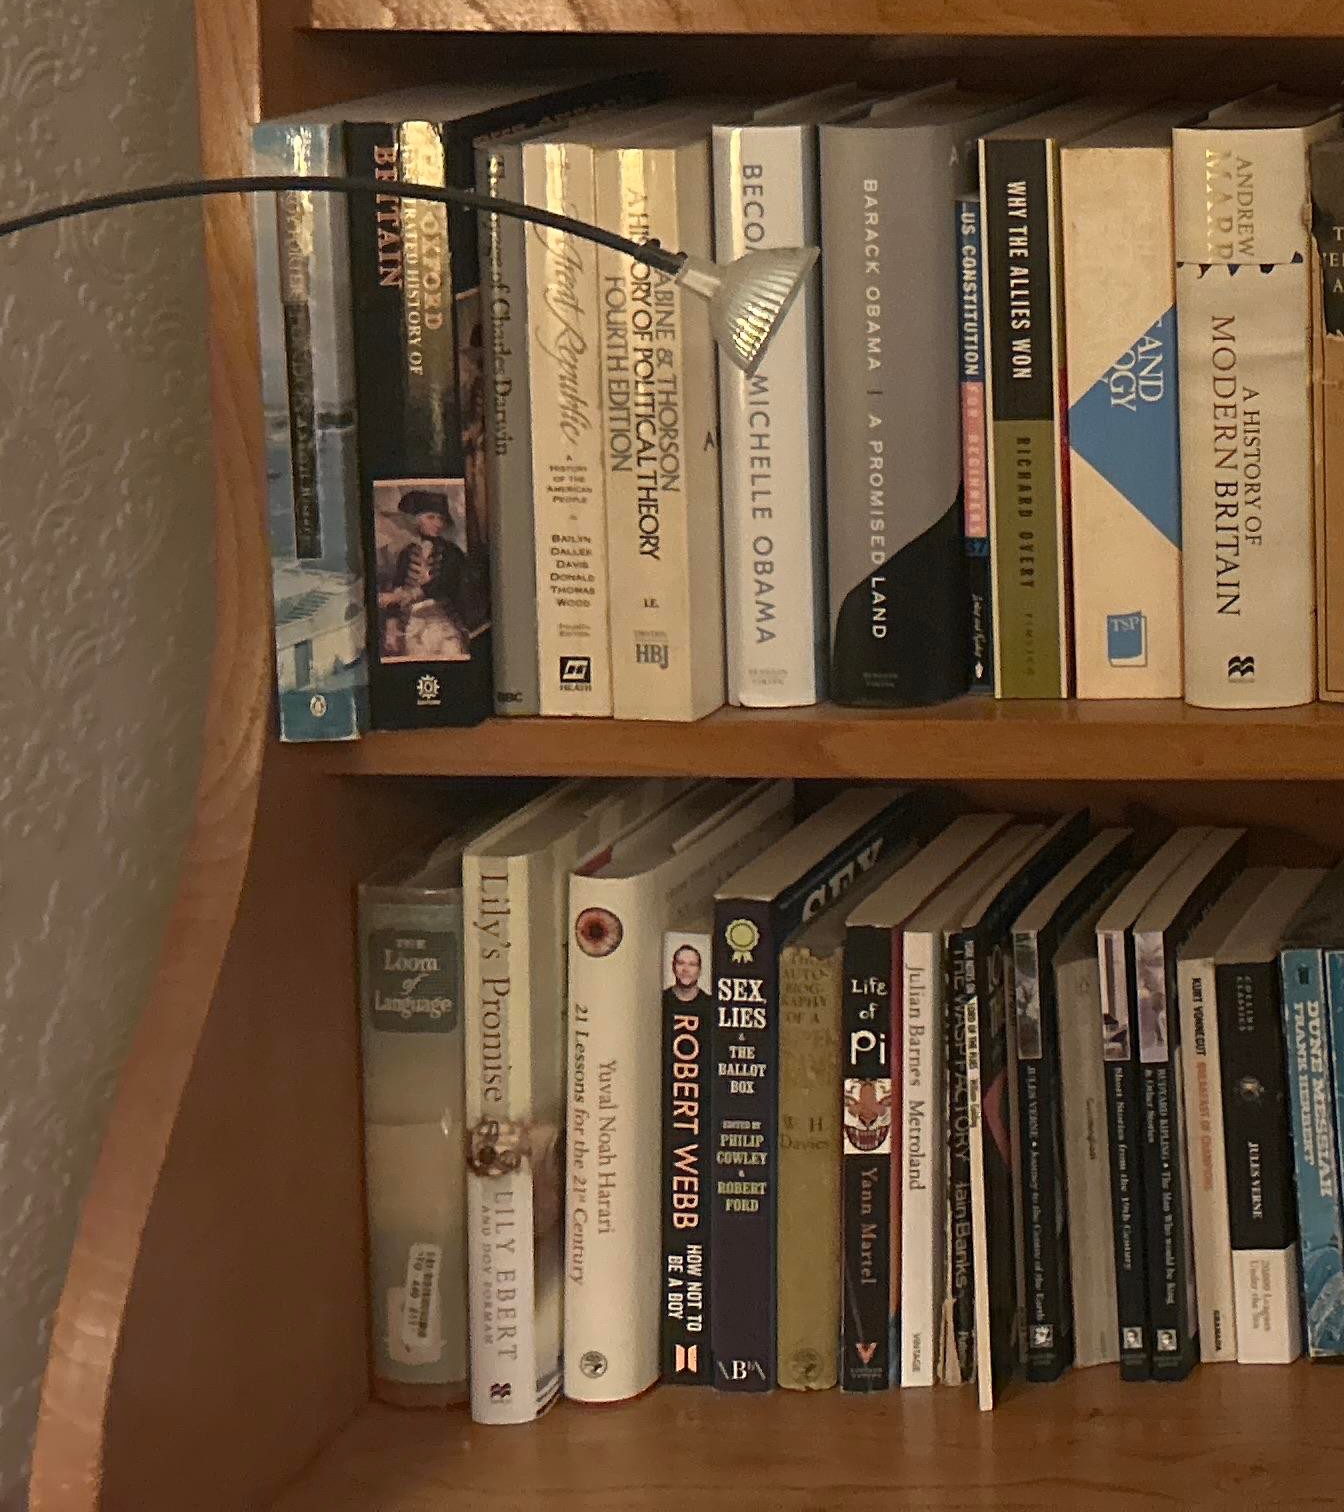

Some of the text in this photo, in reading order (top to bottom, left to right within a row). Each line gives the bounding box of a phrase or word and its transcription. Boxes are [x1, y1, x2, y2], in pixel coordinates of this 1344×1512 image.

[745, 376, 776, 645] MICHELLE OBAMA
[1211, 316, 1240, 616] MODERN BRITAIN
[482, 976, 513, 1103] Promise
[718, 1007, 765, 1029] LIES
[851, 978, 887, 996] Life
[852, 1032, 885, 1065] Pi
[671, 1013, 699, 1228] ROBERT WEBB
